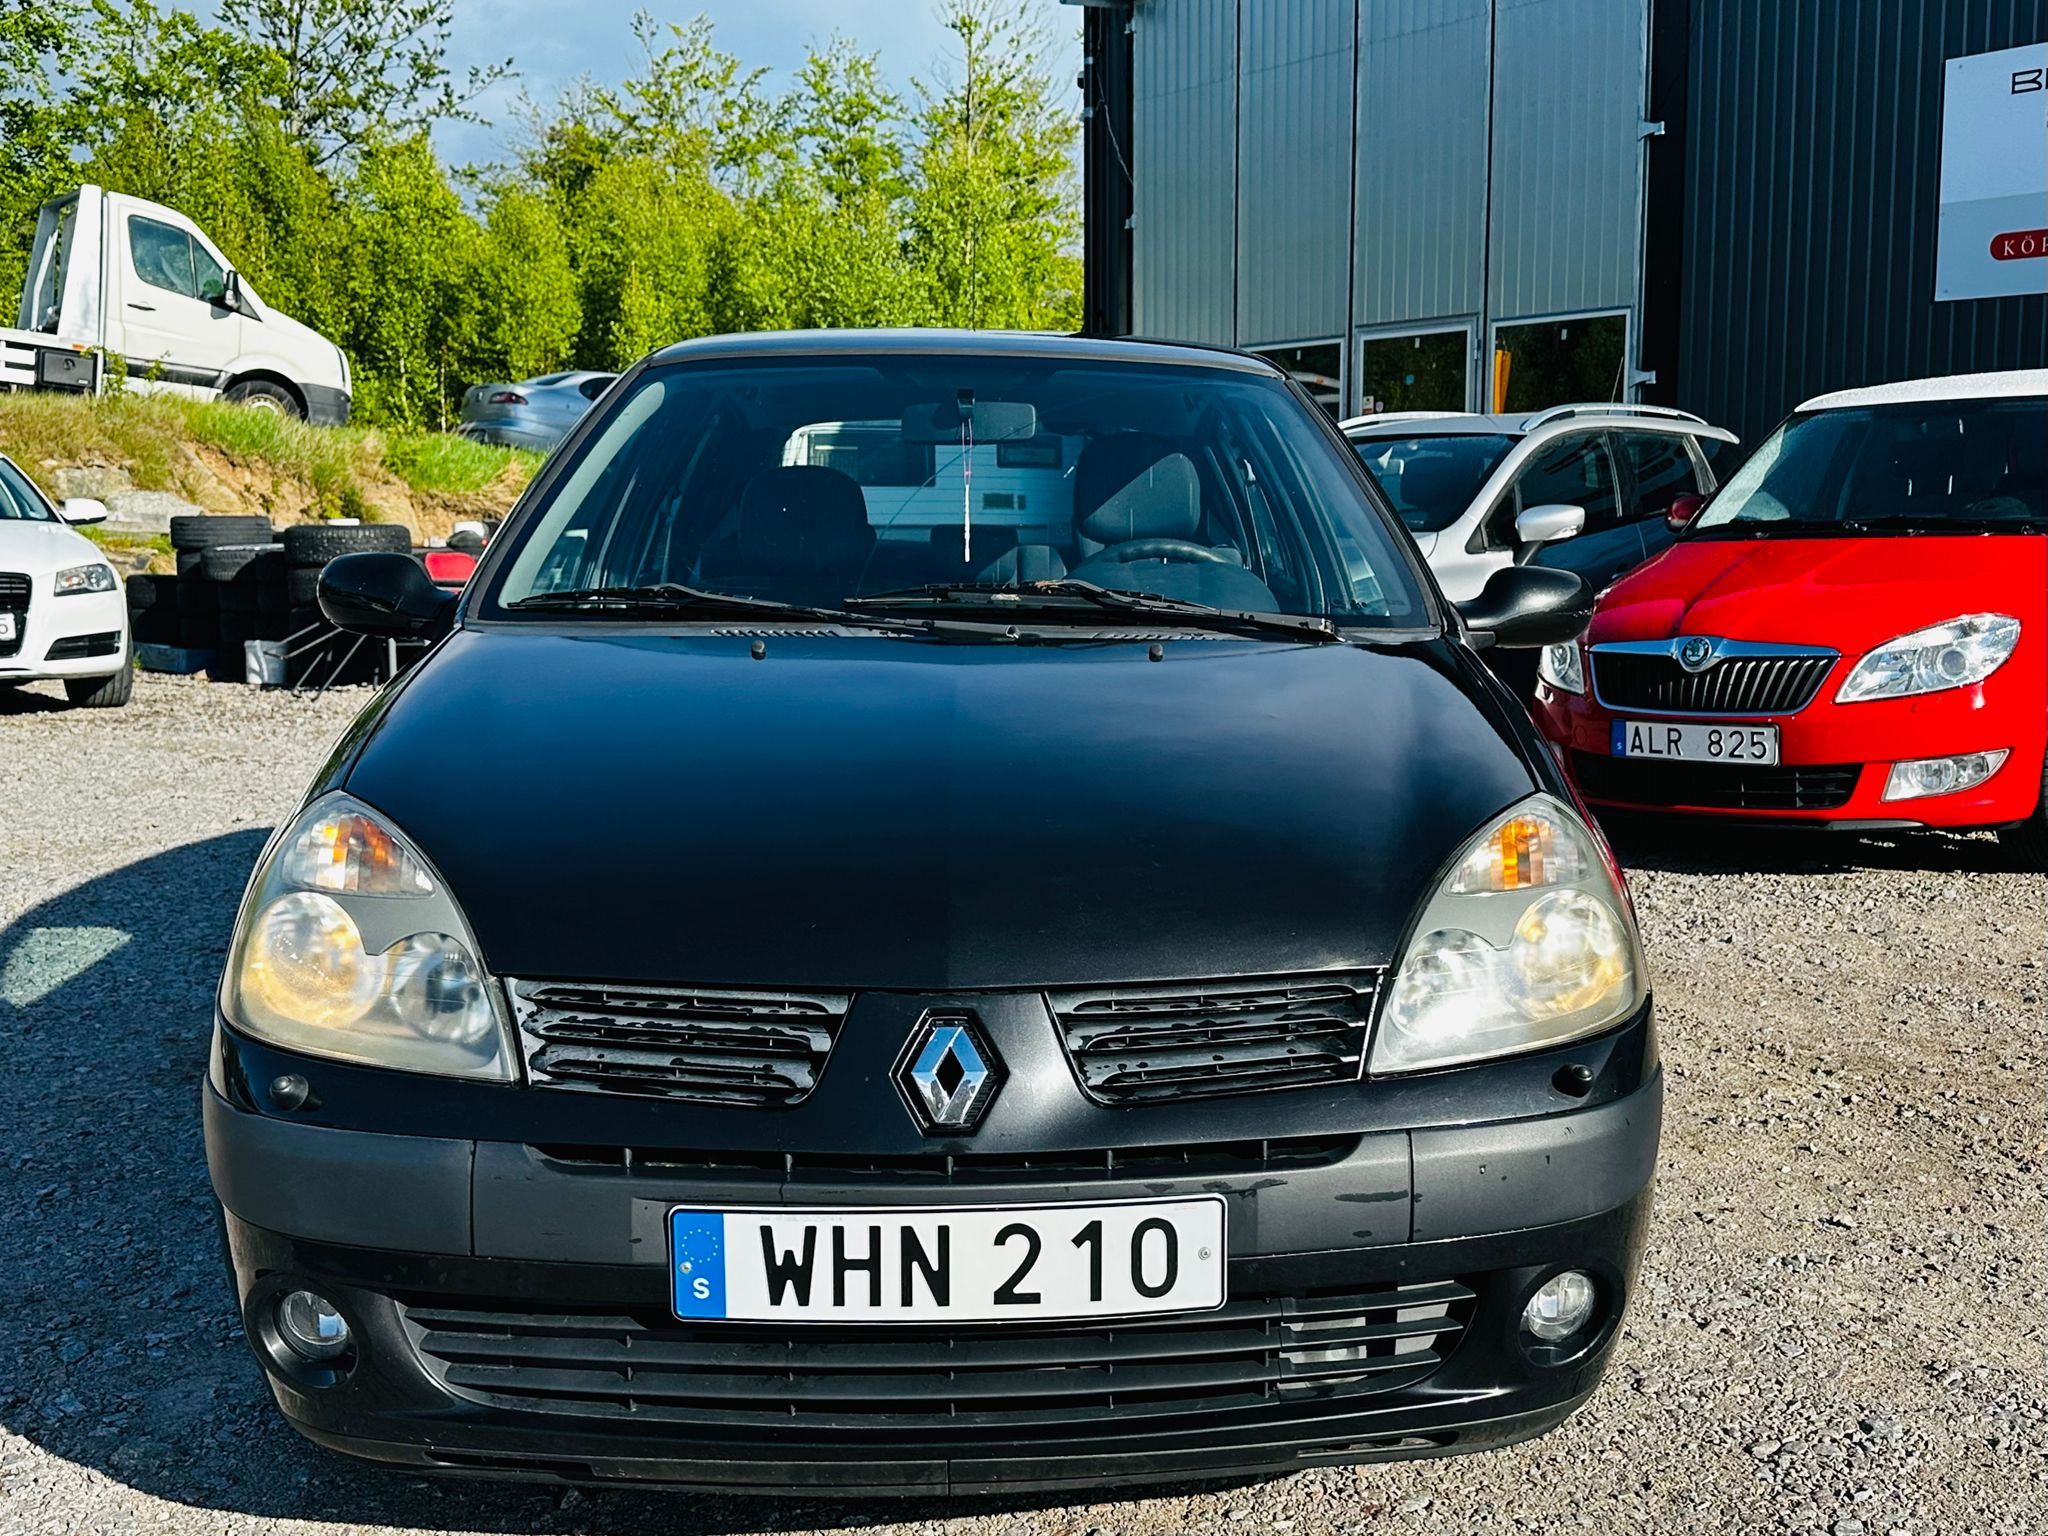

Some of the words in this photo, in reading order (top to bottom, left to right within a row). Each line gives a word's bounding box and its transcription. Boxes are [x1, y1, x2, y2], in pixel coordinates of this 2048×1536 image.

[2011, 68, 2048, 95] B
[1630, 725, 1683, 756] ALR
[1707, 729, 1767, 760] 825
[760, 1225, 951, 1307] WHN
[993, 1217, 1178, 1305] 210
[693, 1277, 710, 1300] S
